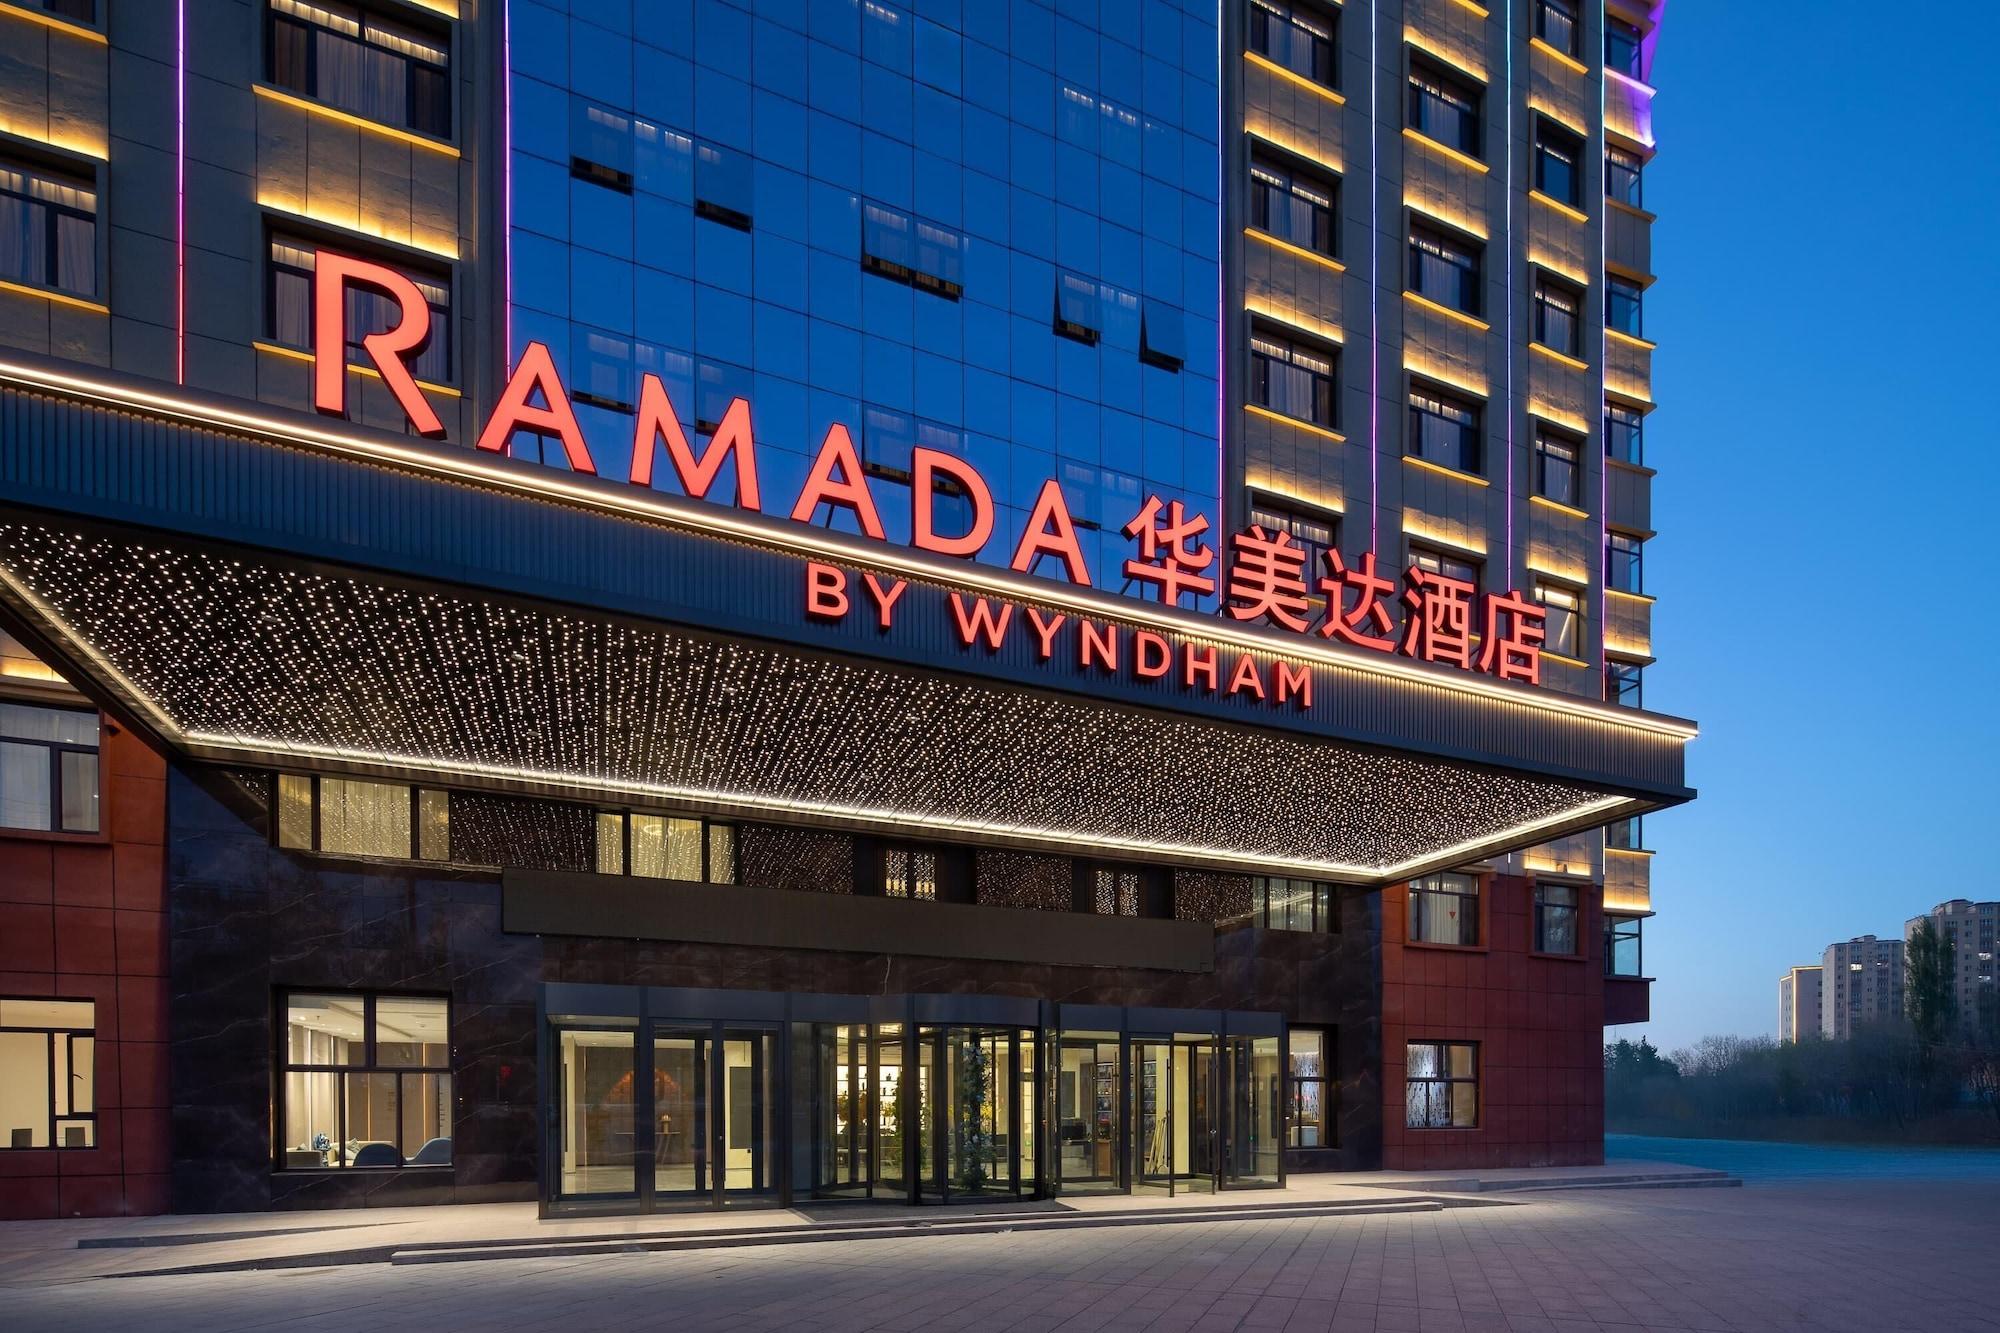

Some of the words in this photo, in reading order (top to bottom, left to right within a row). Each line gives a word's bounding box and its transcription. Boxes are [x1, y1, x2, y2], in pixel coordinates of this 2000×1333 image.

[313, 249, 1092, 587] RAMADA
[806, 561, 908, 629] BY
[949, 591, 1313, 708] WYNDHAM
[1123, 495, 1547, 685] 华美达酒店
